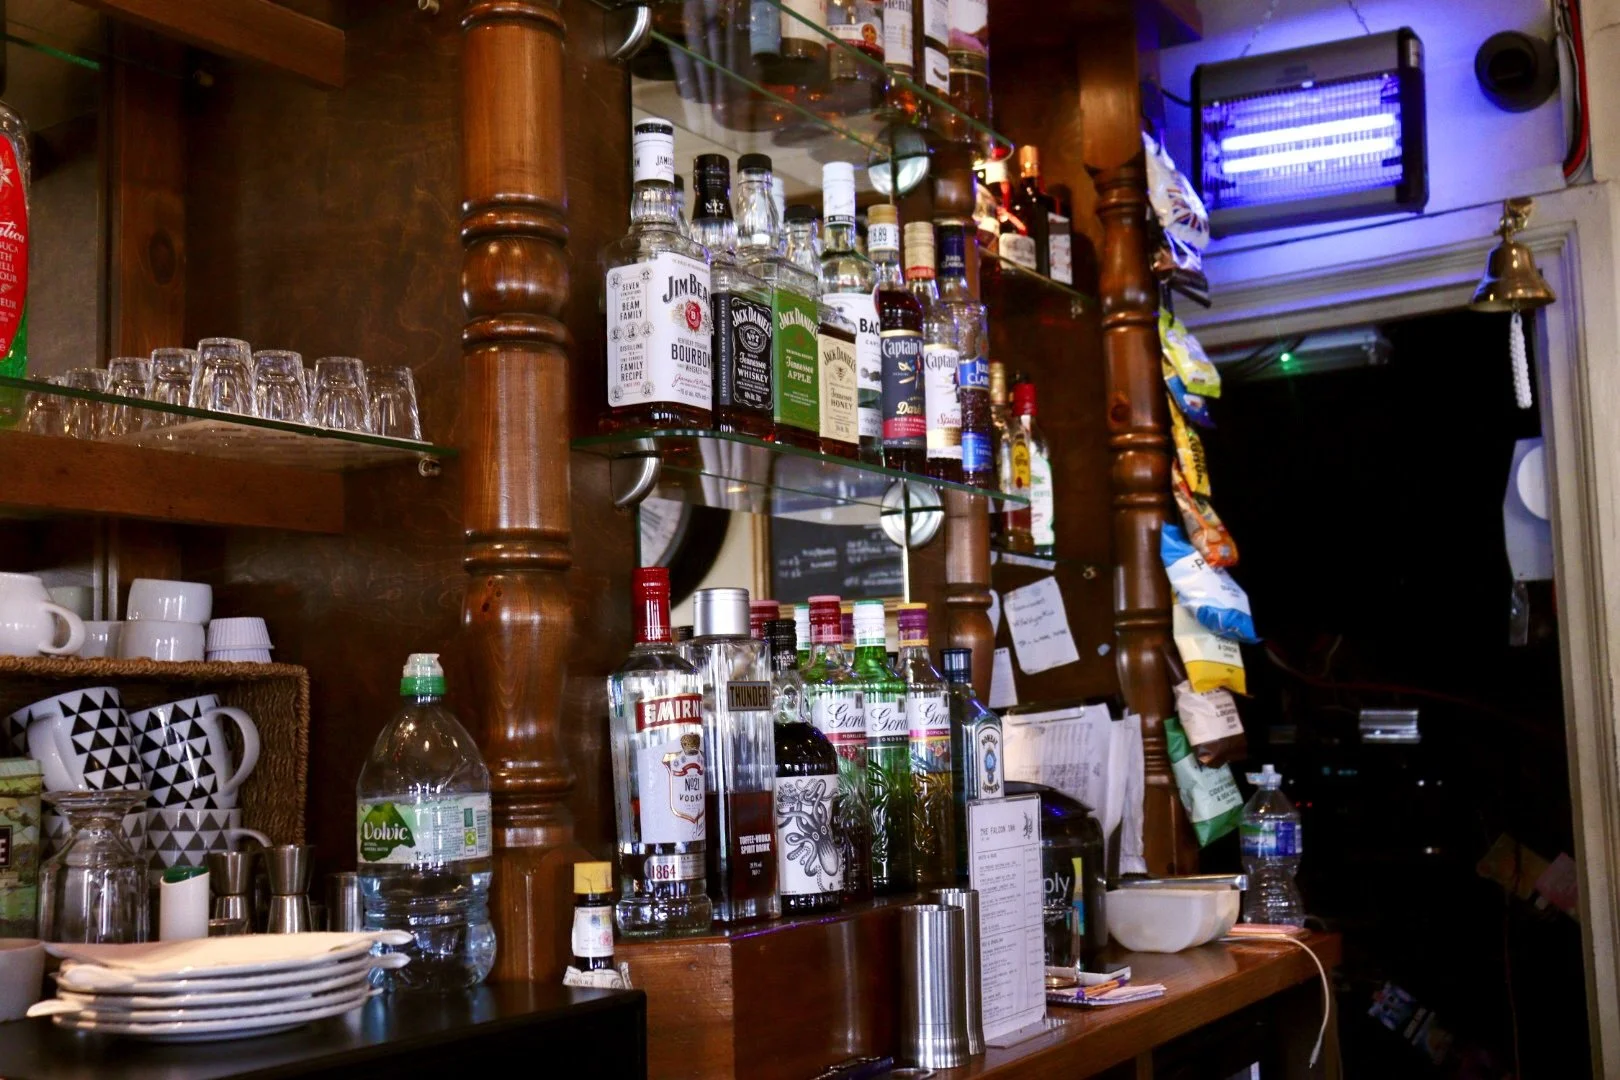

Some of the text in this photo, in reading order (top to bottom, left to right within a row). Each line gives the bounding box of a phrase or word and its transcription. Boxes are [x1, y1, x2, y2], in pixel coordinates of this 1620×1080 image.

[0, 251, 12, 262] TH
[0, 271, 17, 283] OUR
[622, 281, 640, 291] SEVEN
[0, 297, 17, 310] EUR
[622, 300, 640, 311] BEAM
[620, 310, 642, 320] FAMILY
[731, 308, 748, 327] JACK
[779, 310, 796, 330] JACK
[620, 343, 643, 352] DISTILLING
[882, 337, 918, 358] Captain
[671, 343, 711, 369] BOURBON
[823, 351, 836, 366] JACK
[926, 352, 957, 370] Captain
[620, 361, 643, 372] FAMILY
[620, 371, 643, 381] RECIPE
[737, 367, 768, 384] WHISKEY
[787, 370, 812, 384] APPLE
[830, 400, 853, 410] HONEY
[729, 684, 769, 708] THUNDER
[827, 703, 865, 728] Gord
[870, 707, 908, 732] Gord
[679, 794, 703, 802] VODKA
[363, 821, 408, 840] Volvic
[990, 825, 1006, 835] FALCON
[652, 864, 676, 879] 1864
[1044, 872, 1070, 897] ply
